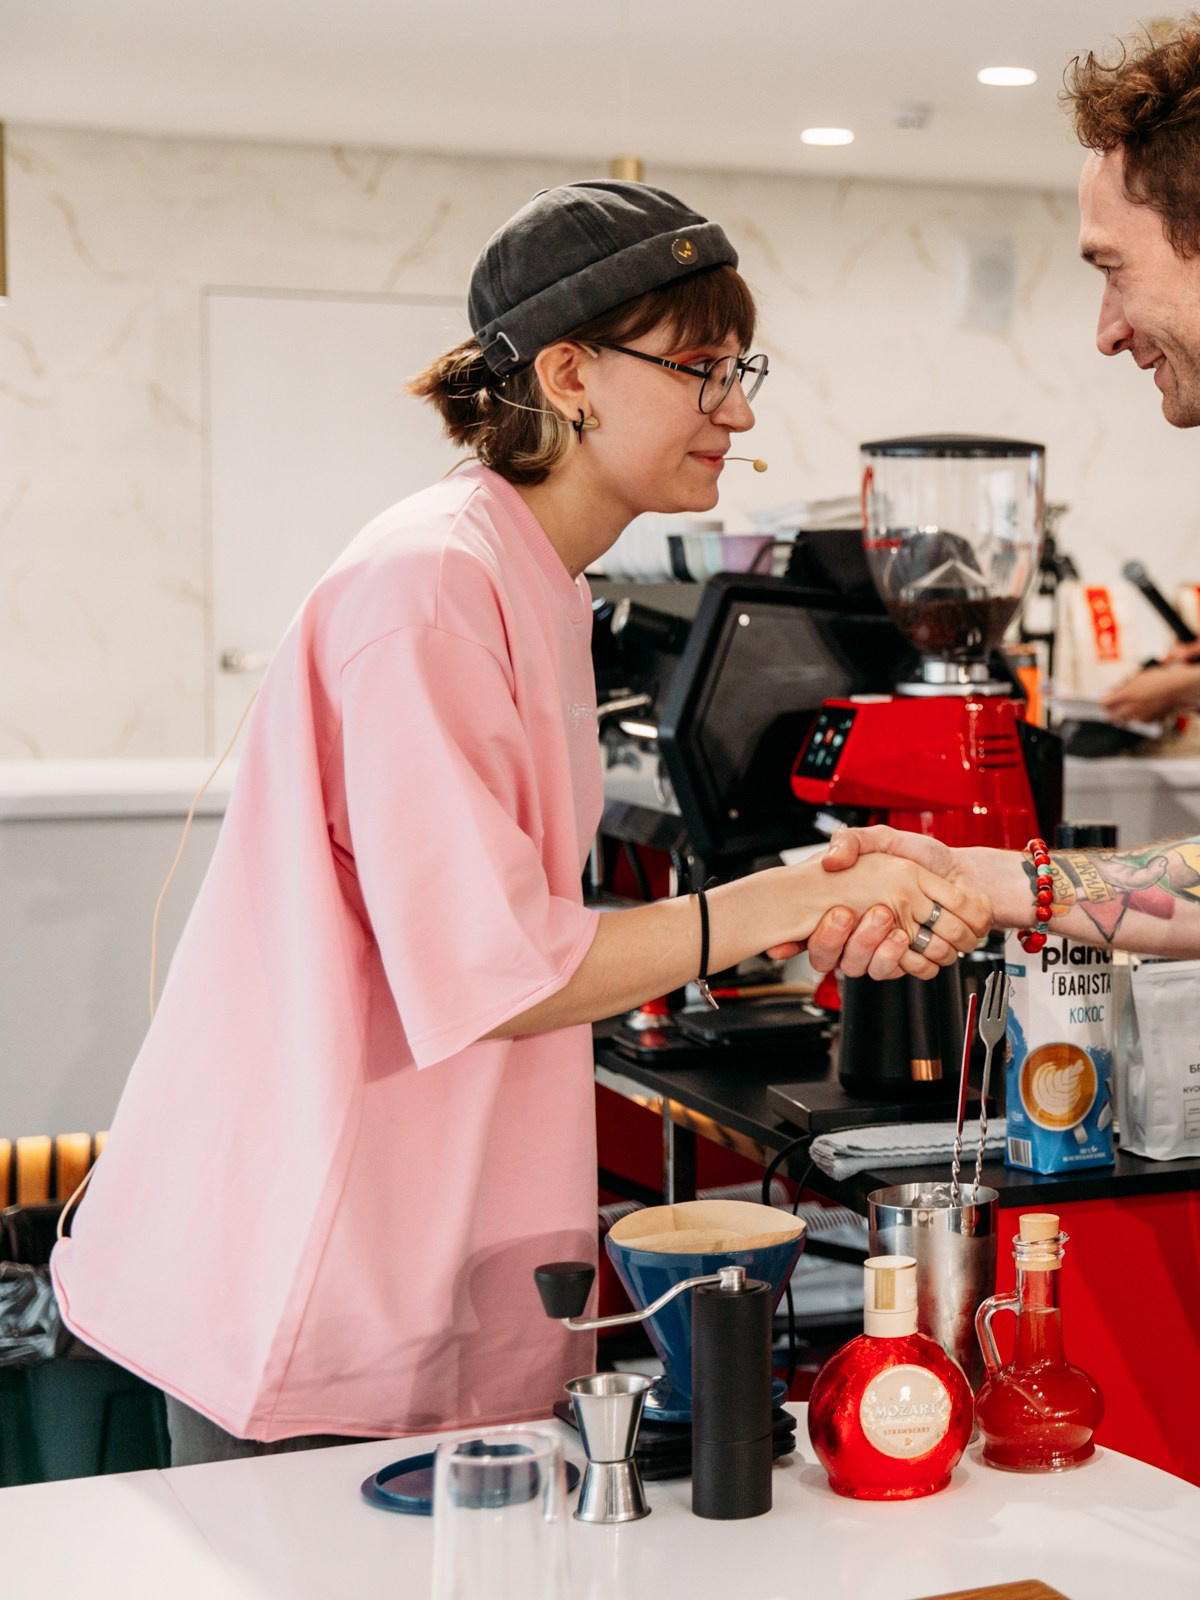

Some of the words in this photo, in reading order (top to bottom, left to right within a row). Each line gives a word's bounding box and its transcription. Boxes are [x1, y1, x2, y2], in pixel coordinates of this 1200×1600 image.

[1058, 973, 1112, 996] BARISTA
[1069, 1005, 1104, 1024] КОКОС
[874, 1403, 937, 1419] MOZART
[883, 1426, 930, 1436] STRAWBERRY
